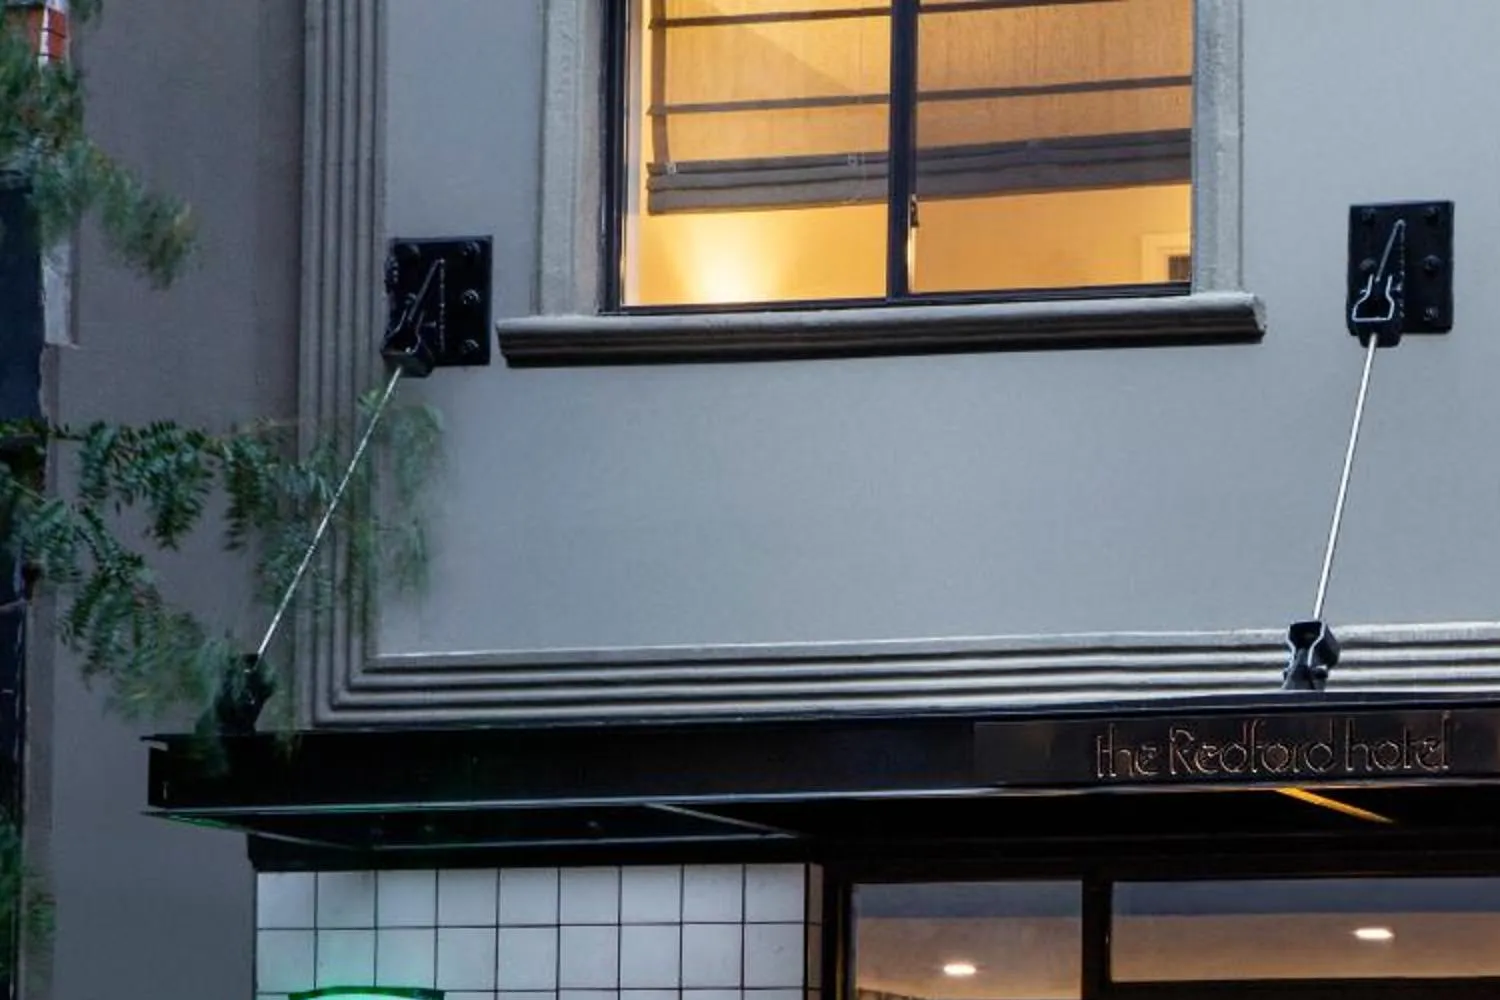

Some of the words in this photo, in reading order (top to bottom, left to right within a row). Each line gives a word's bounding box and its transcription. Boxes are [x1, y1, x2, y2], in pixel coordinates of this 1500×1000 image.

[1096, 722, 1160, 778] the
[1168, 717, 1336, 775] Redford
[1344, 710, 1451, 773] hotel
